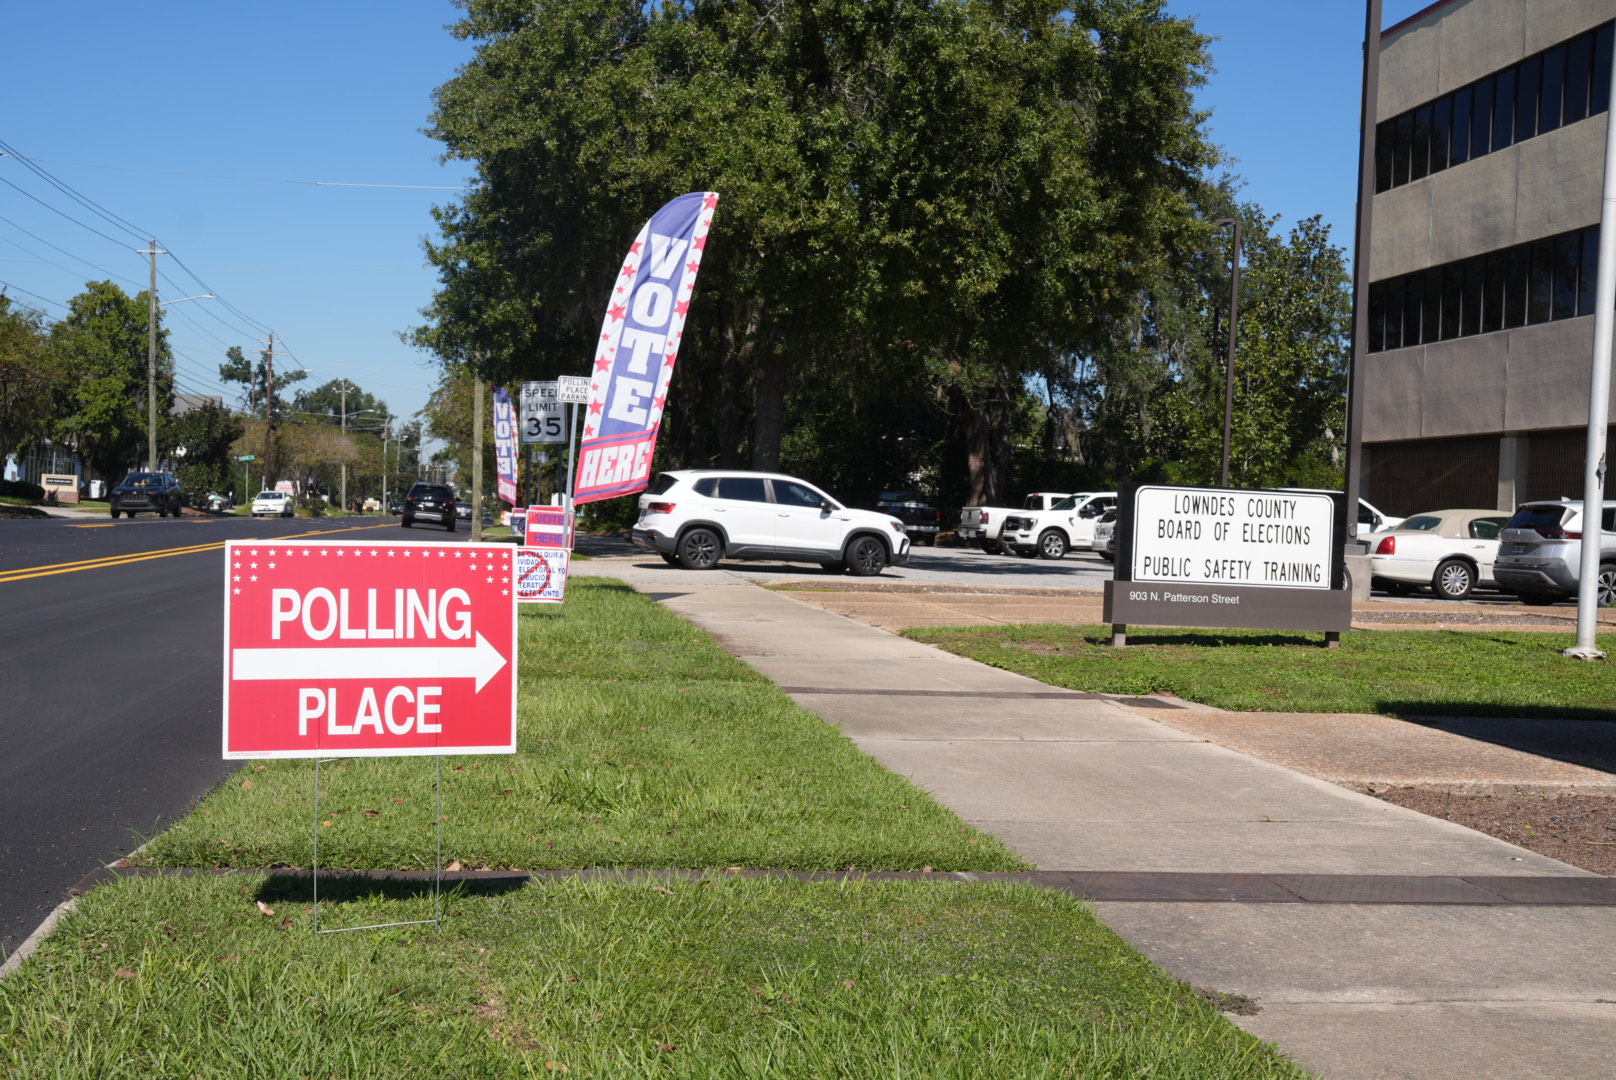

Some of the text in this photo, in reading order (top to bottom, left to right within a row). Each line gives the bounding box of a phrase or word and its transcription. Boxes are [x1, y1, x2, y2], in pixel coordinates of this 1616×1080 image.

[608, 233, 688, 426] VOTE
[525, 388, 557, 398] SPEE
[561, 393, 589, 401] PARKIN
[566, 386, 588, 394] PLACE
[528, 403, 558, 412] LIMIT
[527, 417, 561, 436] 35
[578, 439, 652, 489] HERE
[1174, 494, 1297, 519] LOWNDES COUNTY
[536, 514, 565, 525] VOTE
[534, 533, 564, 544] HERE
[1158, 519, 1311, 545] BOARD OF ELECTIONS
[1144, 556, 1321, 583] PUBLIC SAFETY TRAINING
[1129, 591, 1240, 604] 903 N. Patterson Street
[271, 586, 472, 641] POLLING
[298, 685, 443, 736] PLACE
